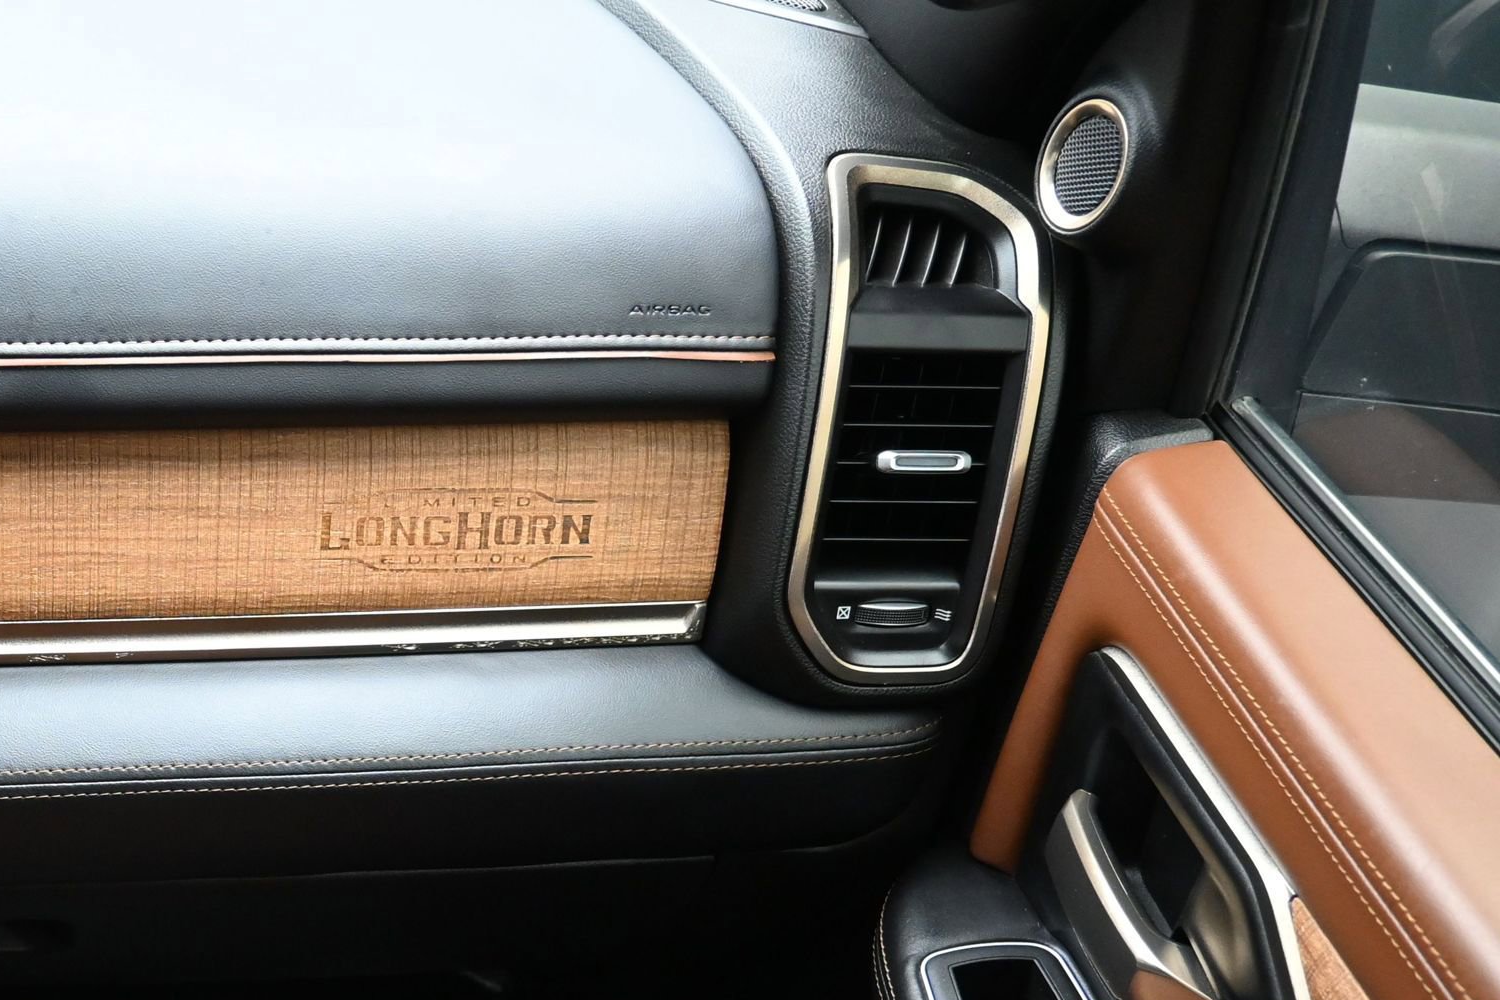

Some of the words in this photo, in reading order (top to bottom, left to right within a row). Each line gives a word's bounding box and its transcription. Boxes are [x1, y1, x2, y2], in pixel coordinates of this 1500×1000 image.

[628, 304, 712, 316] AIRBAG
[384, 496, 531, 508] LMITED
[319, 511, 594, 551] LONGHORN
[380, 553, 528, 565] EDITION
